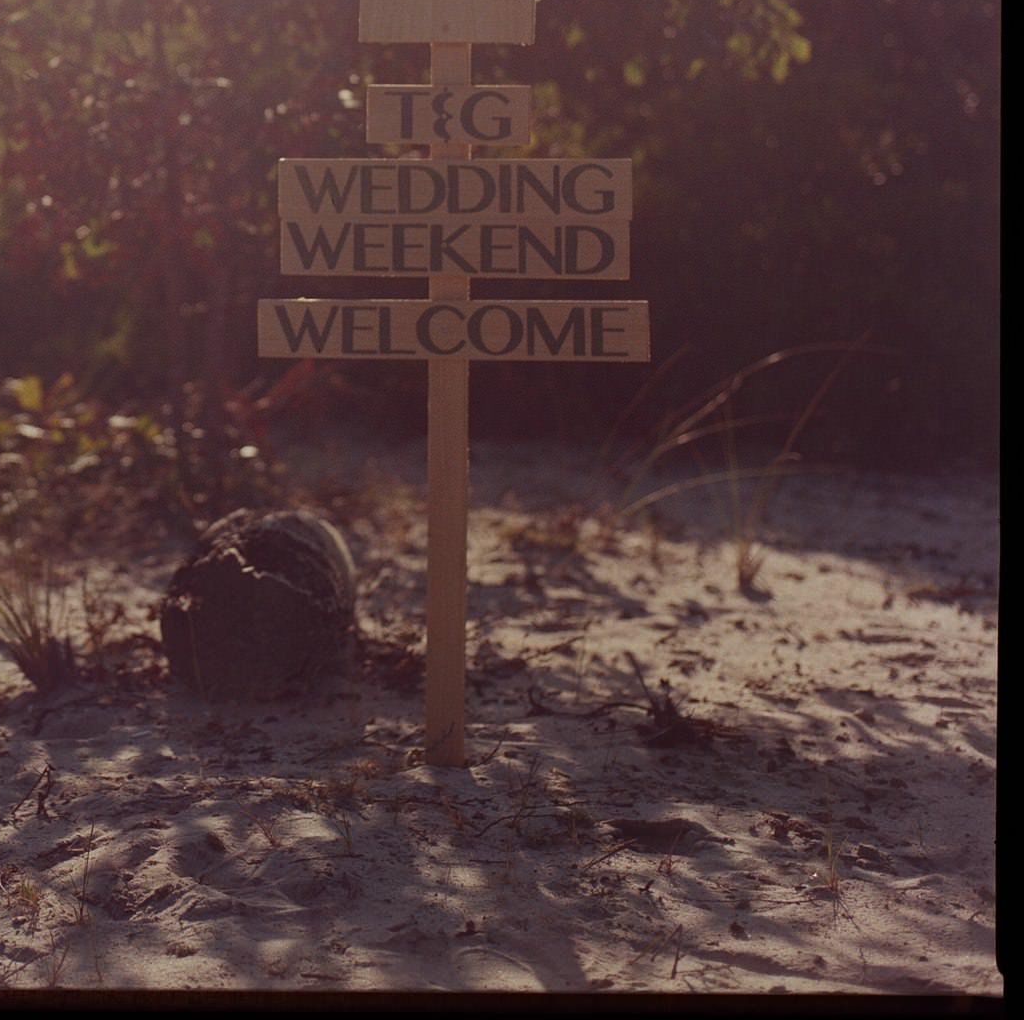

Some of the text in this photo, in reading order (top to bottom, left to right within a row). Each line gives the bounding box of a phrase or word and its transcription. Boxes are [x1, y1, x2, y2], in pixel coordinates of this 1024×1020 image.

[384, 87, 513, 143] T&G
[294, 163, 616, 216] WEDDING
[286, 221, 616, 275] WEEKEND
[275, 304, 630, 357] WELCOME
